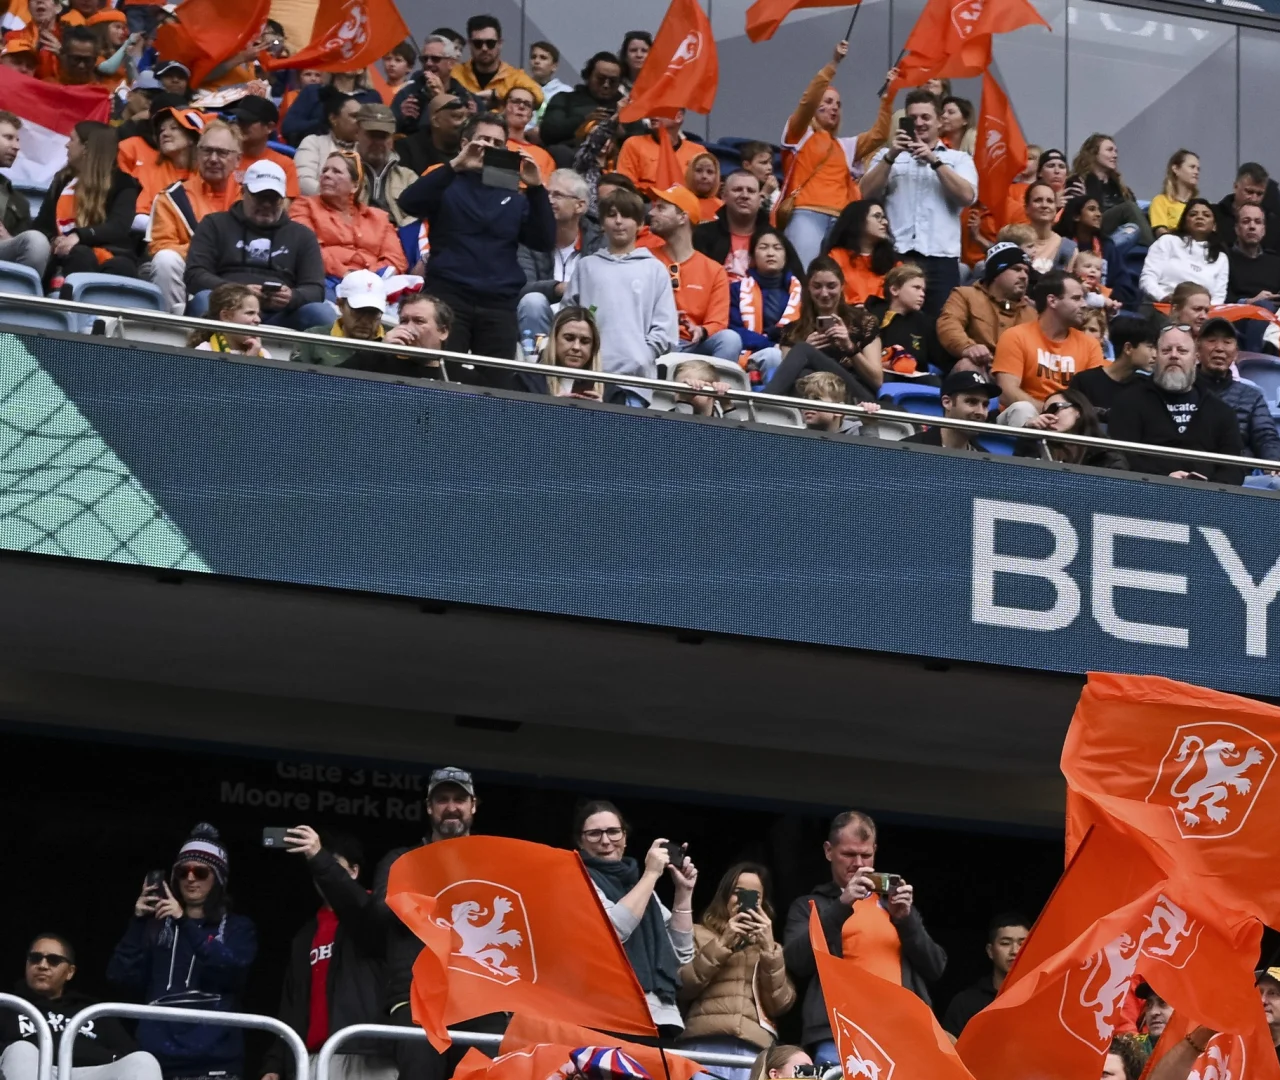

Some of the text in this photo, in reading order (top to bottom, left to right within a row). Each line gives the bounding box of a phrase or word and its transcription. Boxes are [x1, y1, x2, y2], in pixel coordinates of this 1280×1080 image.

[220, 781, 421, 823] Moore Park Rd
